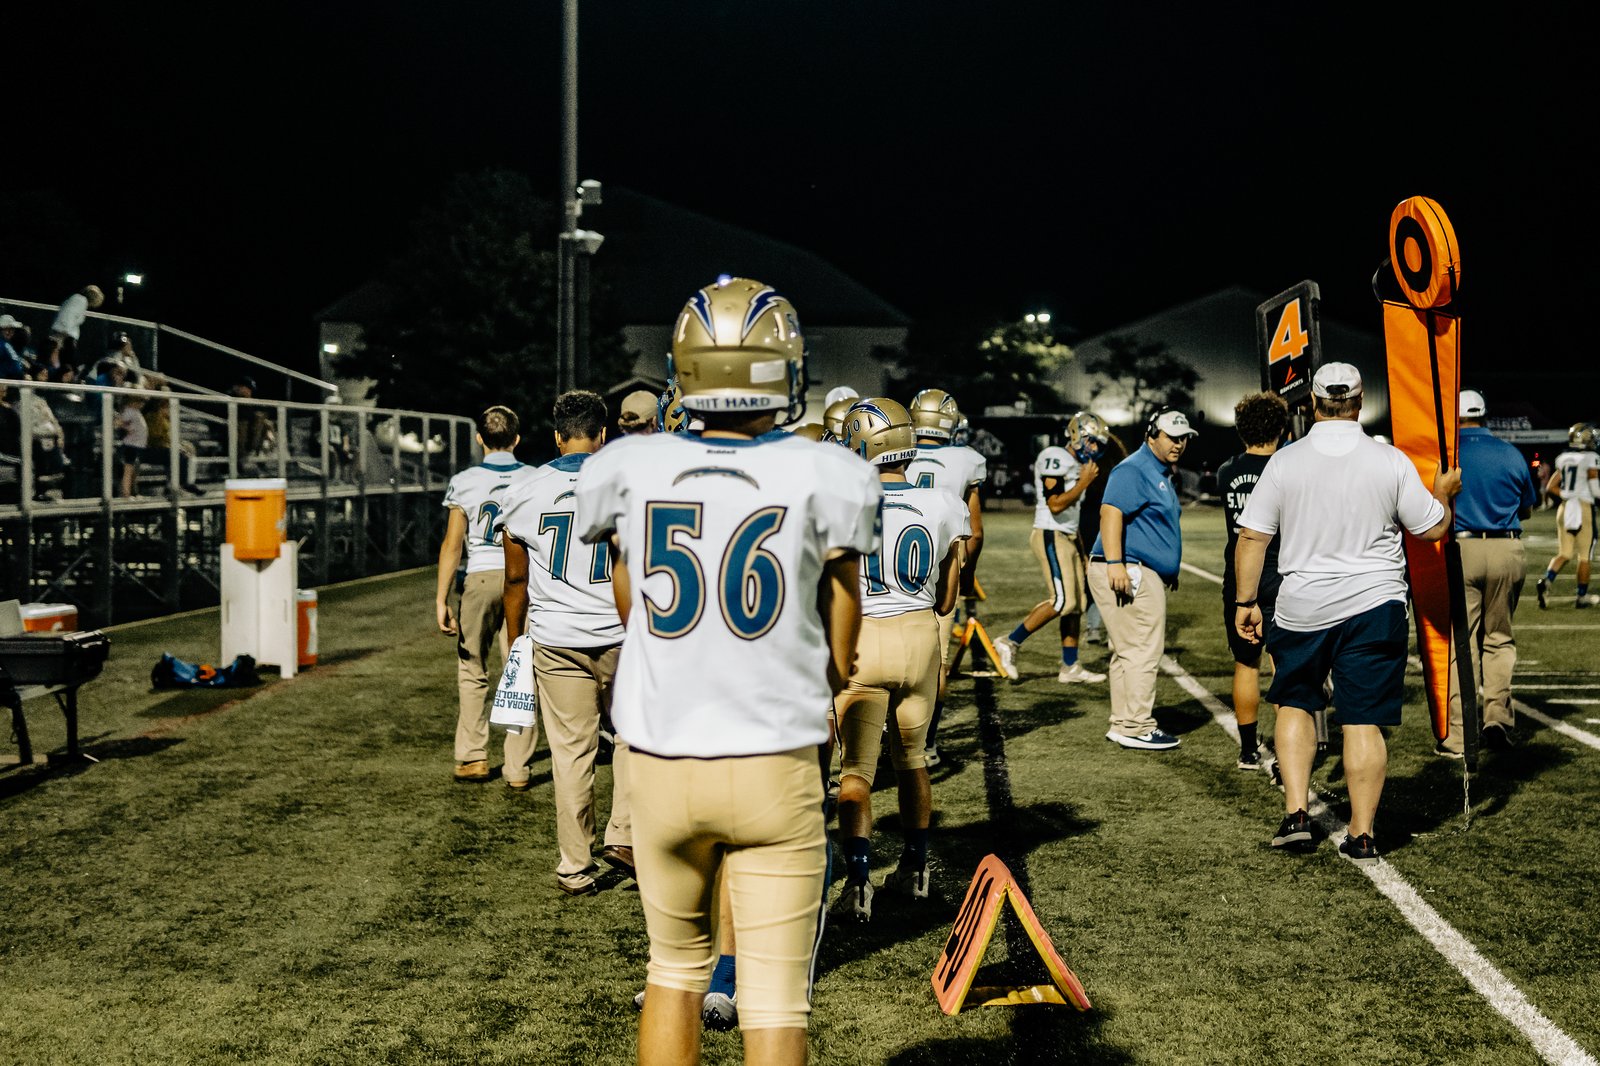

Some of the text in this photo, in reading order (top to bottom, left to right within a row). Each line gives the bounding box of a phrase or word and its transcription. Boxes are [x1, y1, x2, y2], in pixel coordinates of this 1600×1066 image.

[1268, 297, 1309, 365] 4
[695, 397, 770, 409] HIT HARD
[882, 453, 897, 462] HIT
[1044, 458, 1061, 470] 75
[864, 524, 934, 596] 10
[641, 501, 789, 641] 56
[507, 699, 536, 712] URORA
